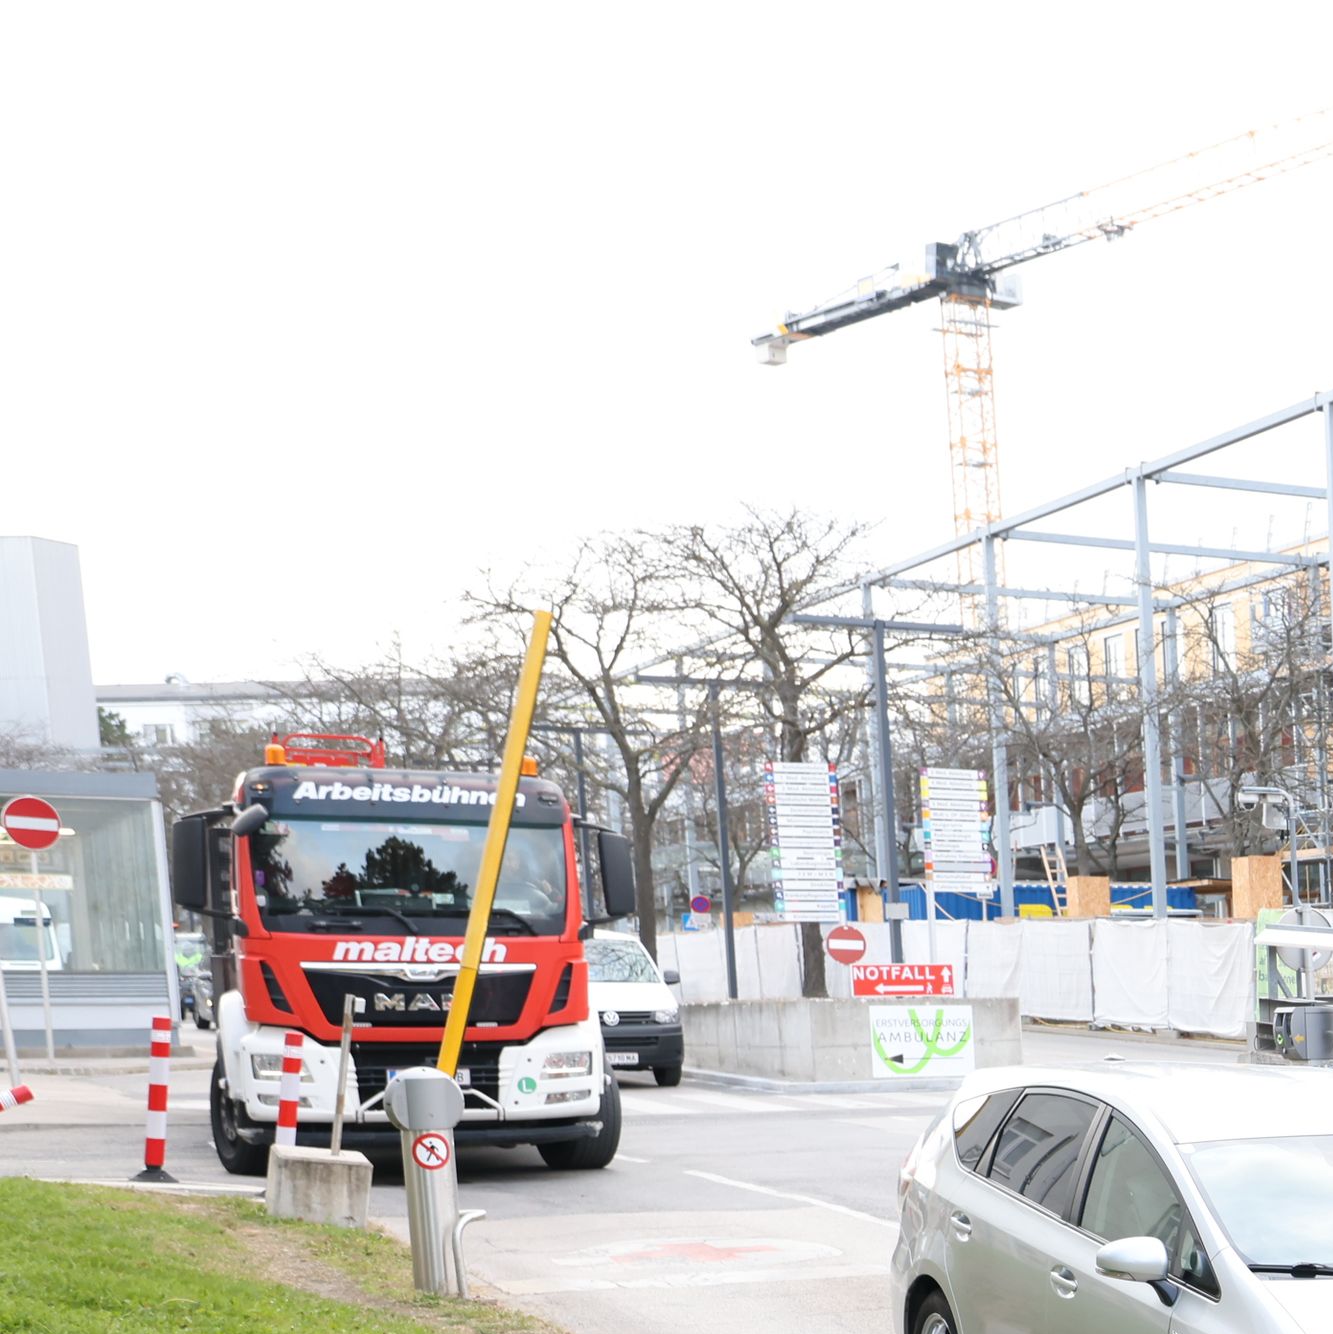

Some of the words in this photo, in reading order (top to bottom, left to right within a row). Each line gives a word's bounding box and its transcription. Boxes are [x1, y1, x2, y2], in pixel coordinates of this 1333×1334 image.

[853, 966, 935, 980] NOTFALL
[875, 1018, 967, 1028] ERSTVERSORGUNGS
[878, 1031, 967, 1043] AMBULANZ
